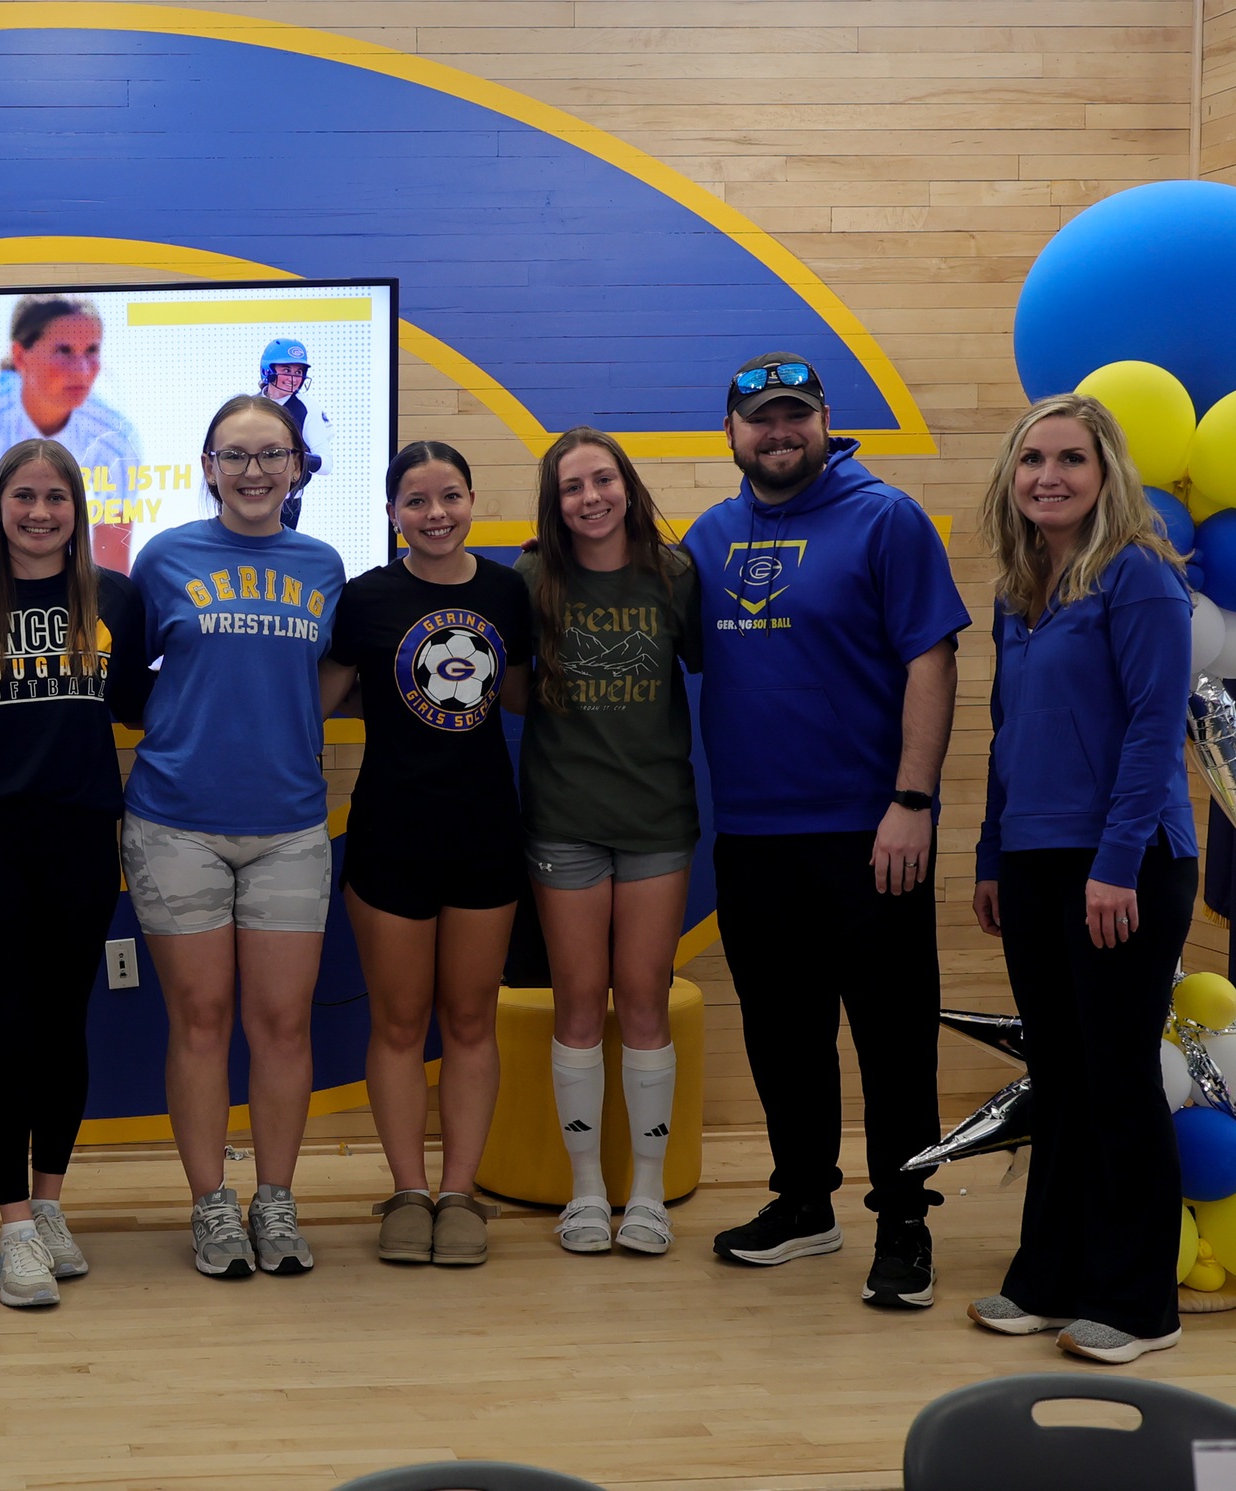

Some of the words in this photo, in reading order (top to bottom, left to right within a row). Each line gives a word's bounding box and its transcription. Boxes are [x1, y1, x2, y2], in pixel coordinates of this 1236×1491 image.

[128, 464, 192, 491] 15TH
[87, 498, 163, 525] DEMY
[185, 566, 326, 618] GERING
[4, 606, 70, 654] NCC
[198, 613, 319, 643] WRESTLING
[423, 612, 487, 633] GERING
[406, 690, 446, 725] GIRLS
